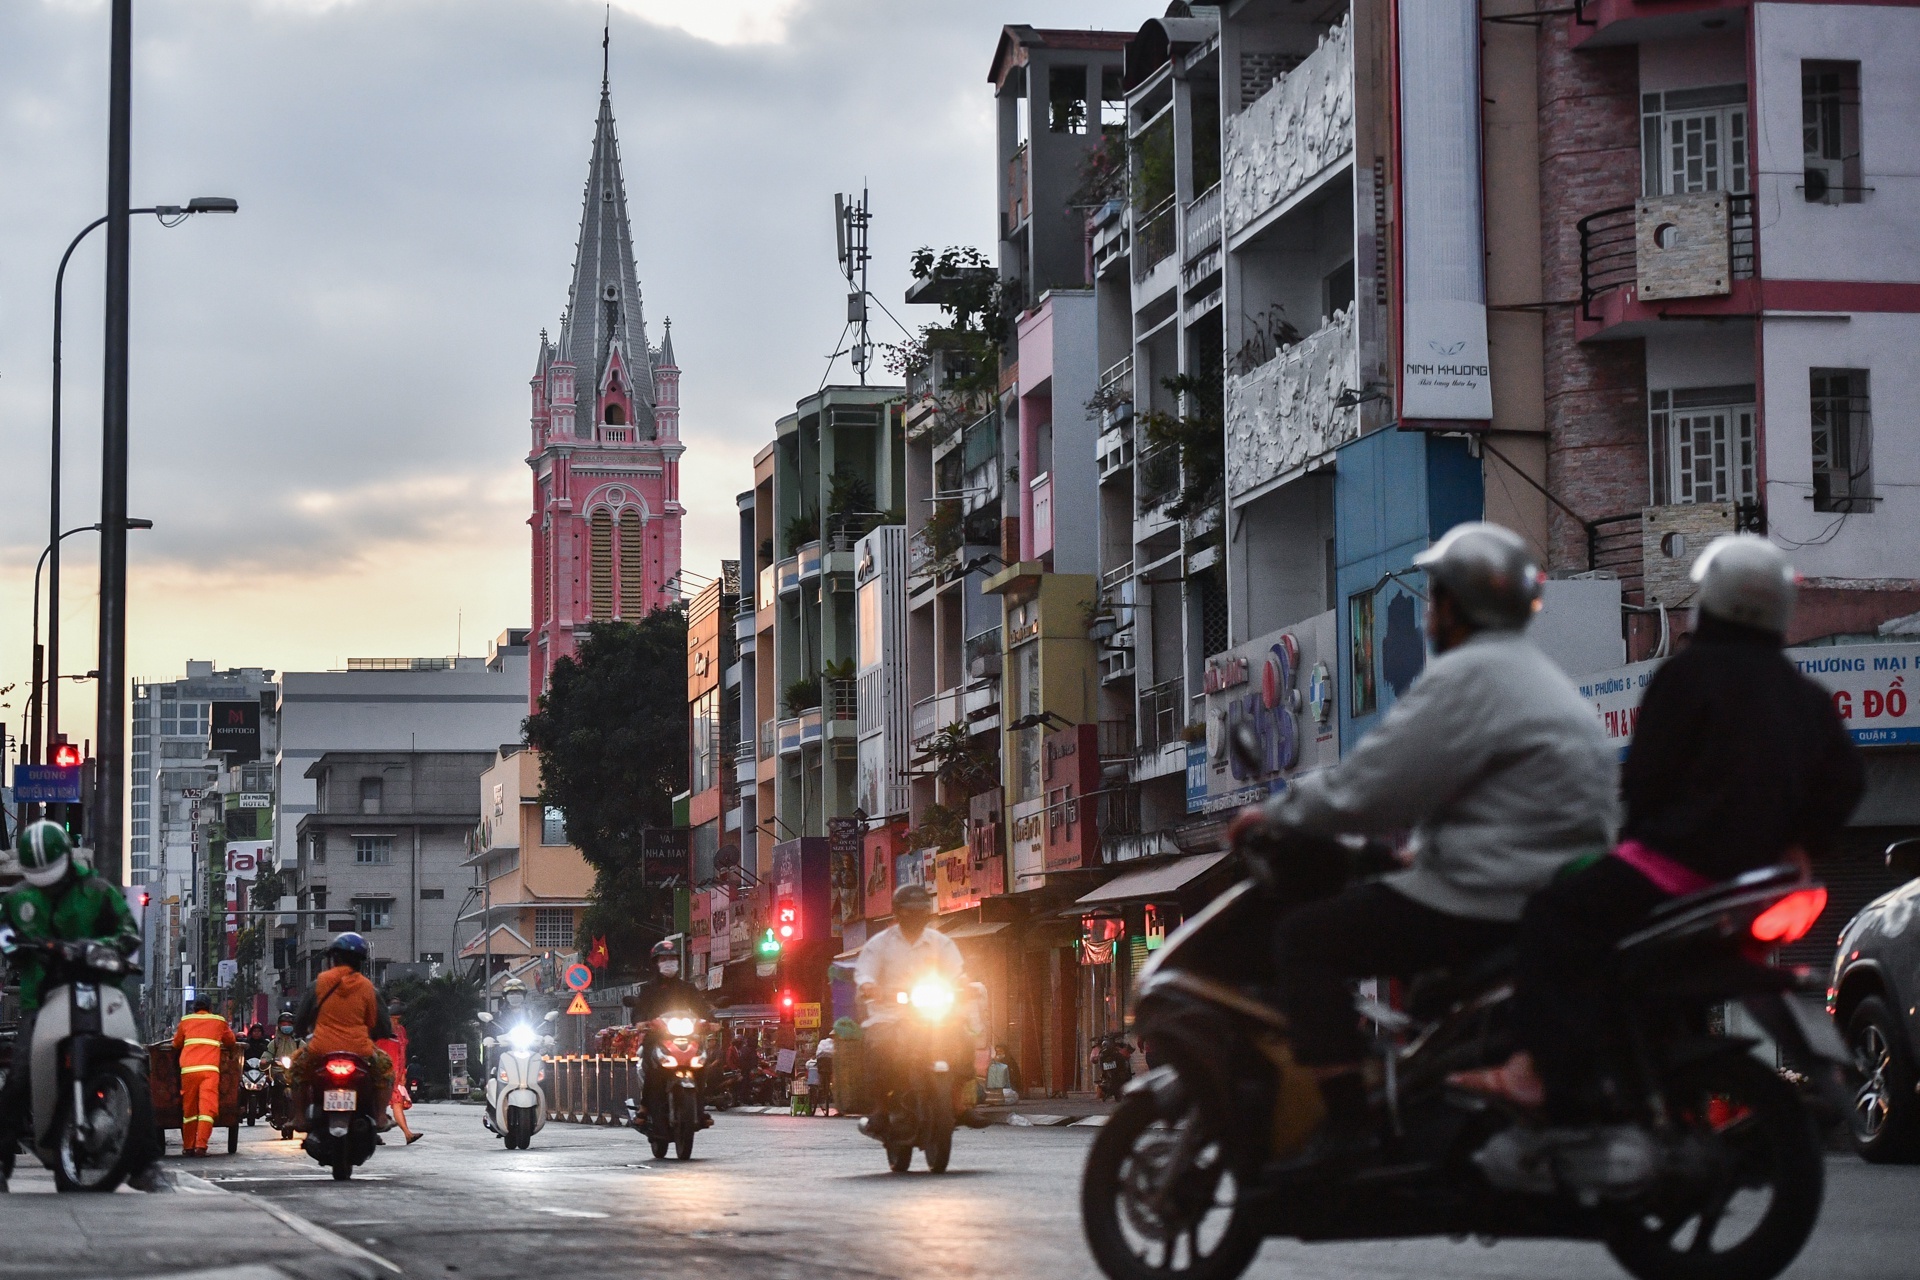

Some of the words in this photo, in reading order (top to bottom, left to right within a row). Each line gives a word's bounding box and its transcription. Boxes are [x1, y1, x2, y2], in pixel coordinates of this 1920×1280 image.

[1407, 364, 1433, 375] NINH
[1438, 364, 1487, 376] KHUONG
[1873, 656, 1906, 672] MẠI
[1626, 677, 1631, 690] 8
[1863, 676, 1907, 718] ĐỒ
[1621, 709, 1628, 736] &
[1859, 731, 1887, 741] QUẬN
[183, 789, 201, 798] A25
[192, 800, 200, 853] HOTEL
[781, 908, 794, 922] 24
